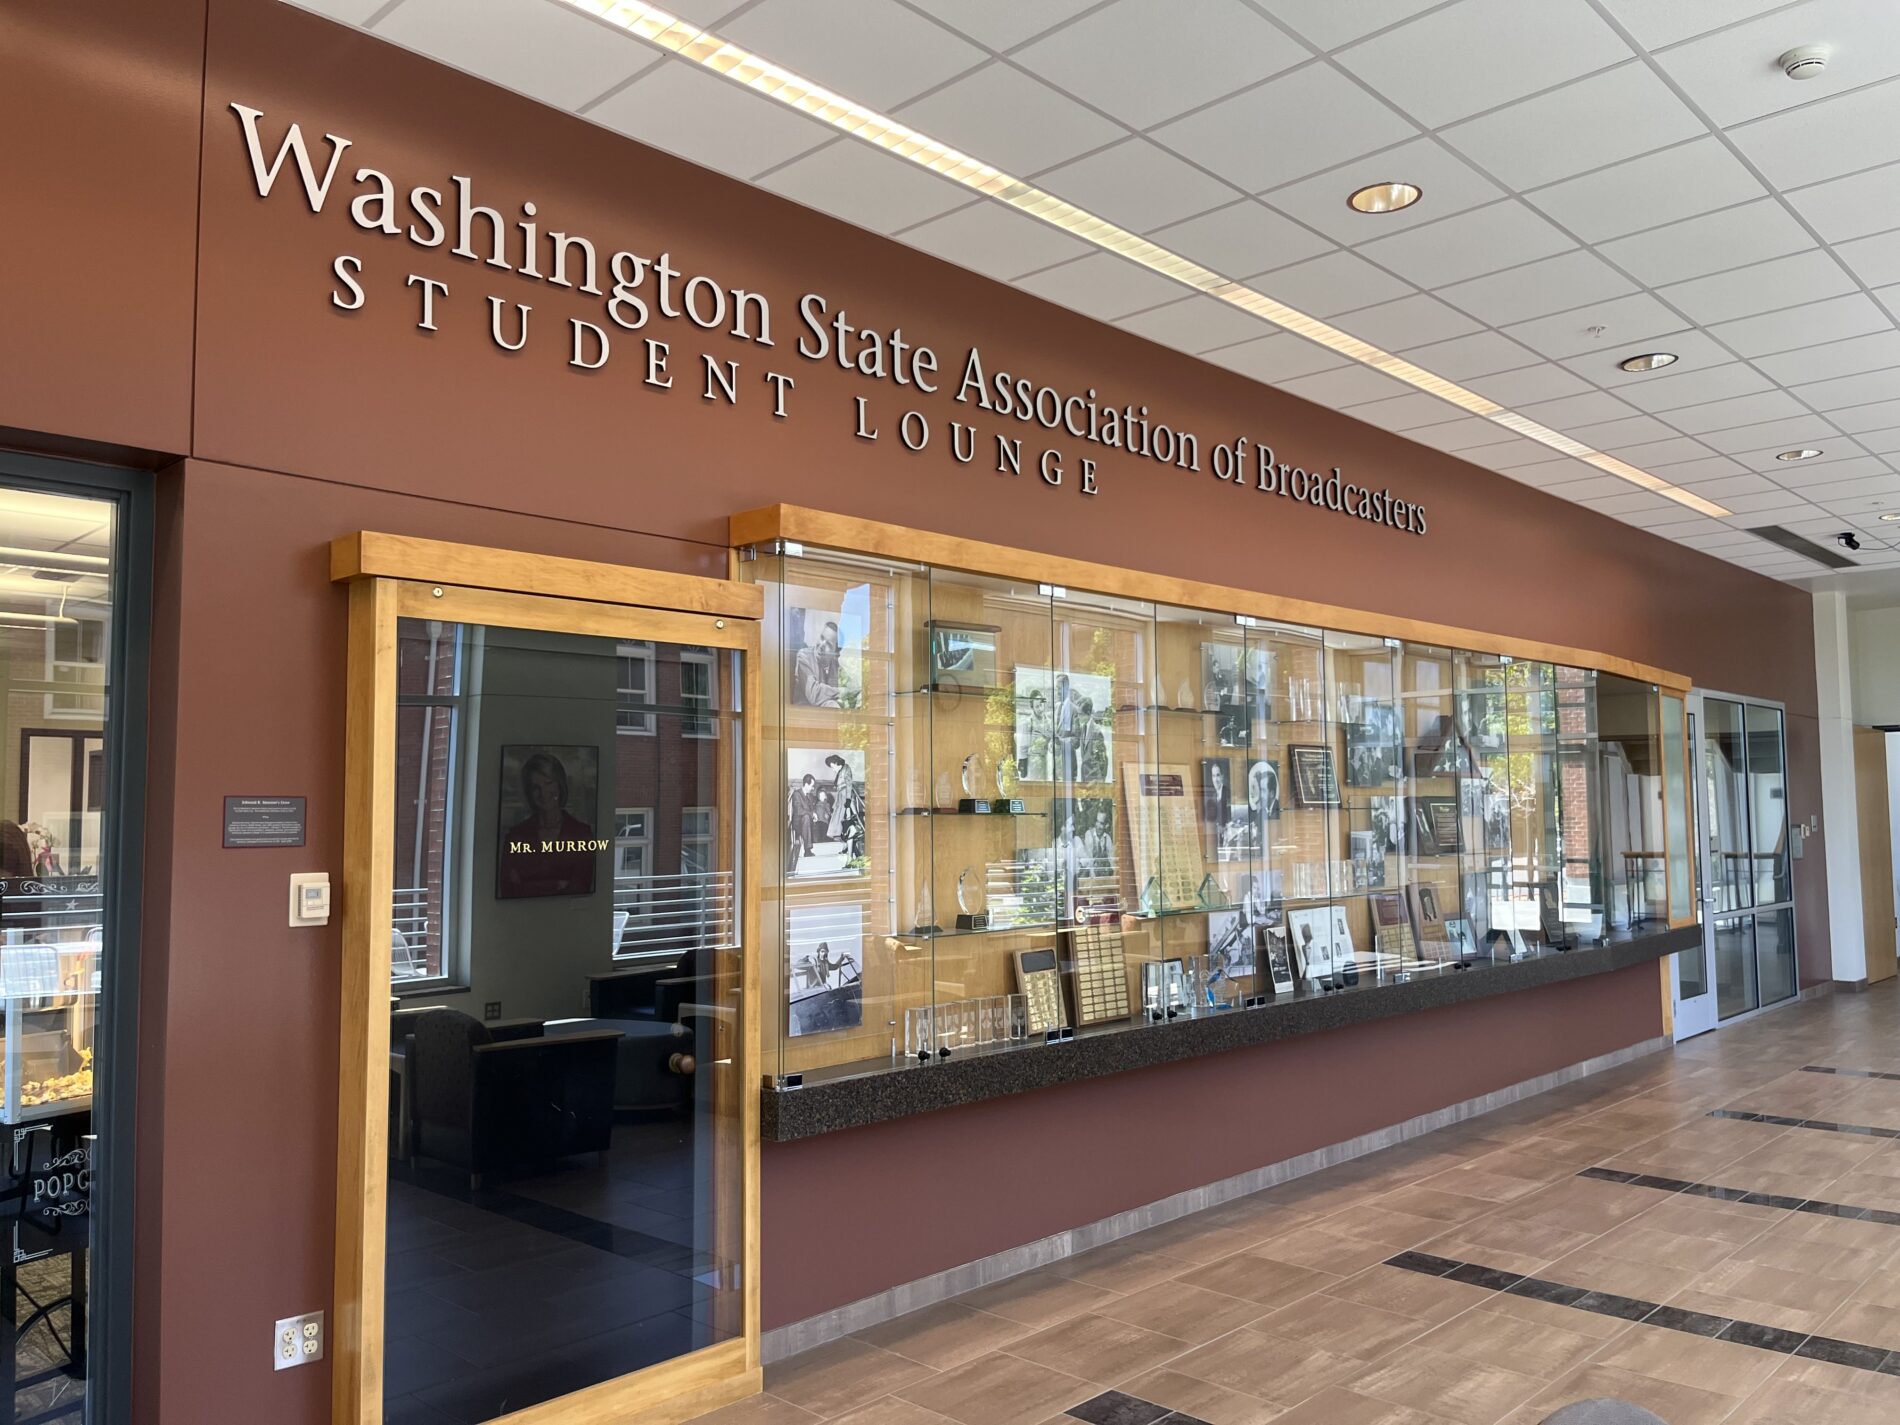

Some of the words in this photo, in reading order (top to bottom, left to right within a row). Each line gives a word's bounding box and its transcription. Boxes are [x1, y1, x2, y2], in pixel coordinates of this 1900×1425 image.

[230, 101, 776, 346] Washington
[800, 293, 939, 393] State
[956, 347, 1201, 472] Association
[1213, 437, 1249, 484] of
[1257, 444, 1428, 536] Broadcasters
[332, 255, 796, 418] STUDENT
[856, 396, 1099, 495] LOUNGE
[541, 839, 610, 853] MURROW
